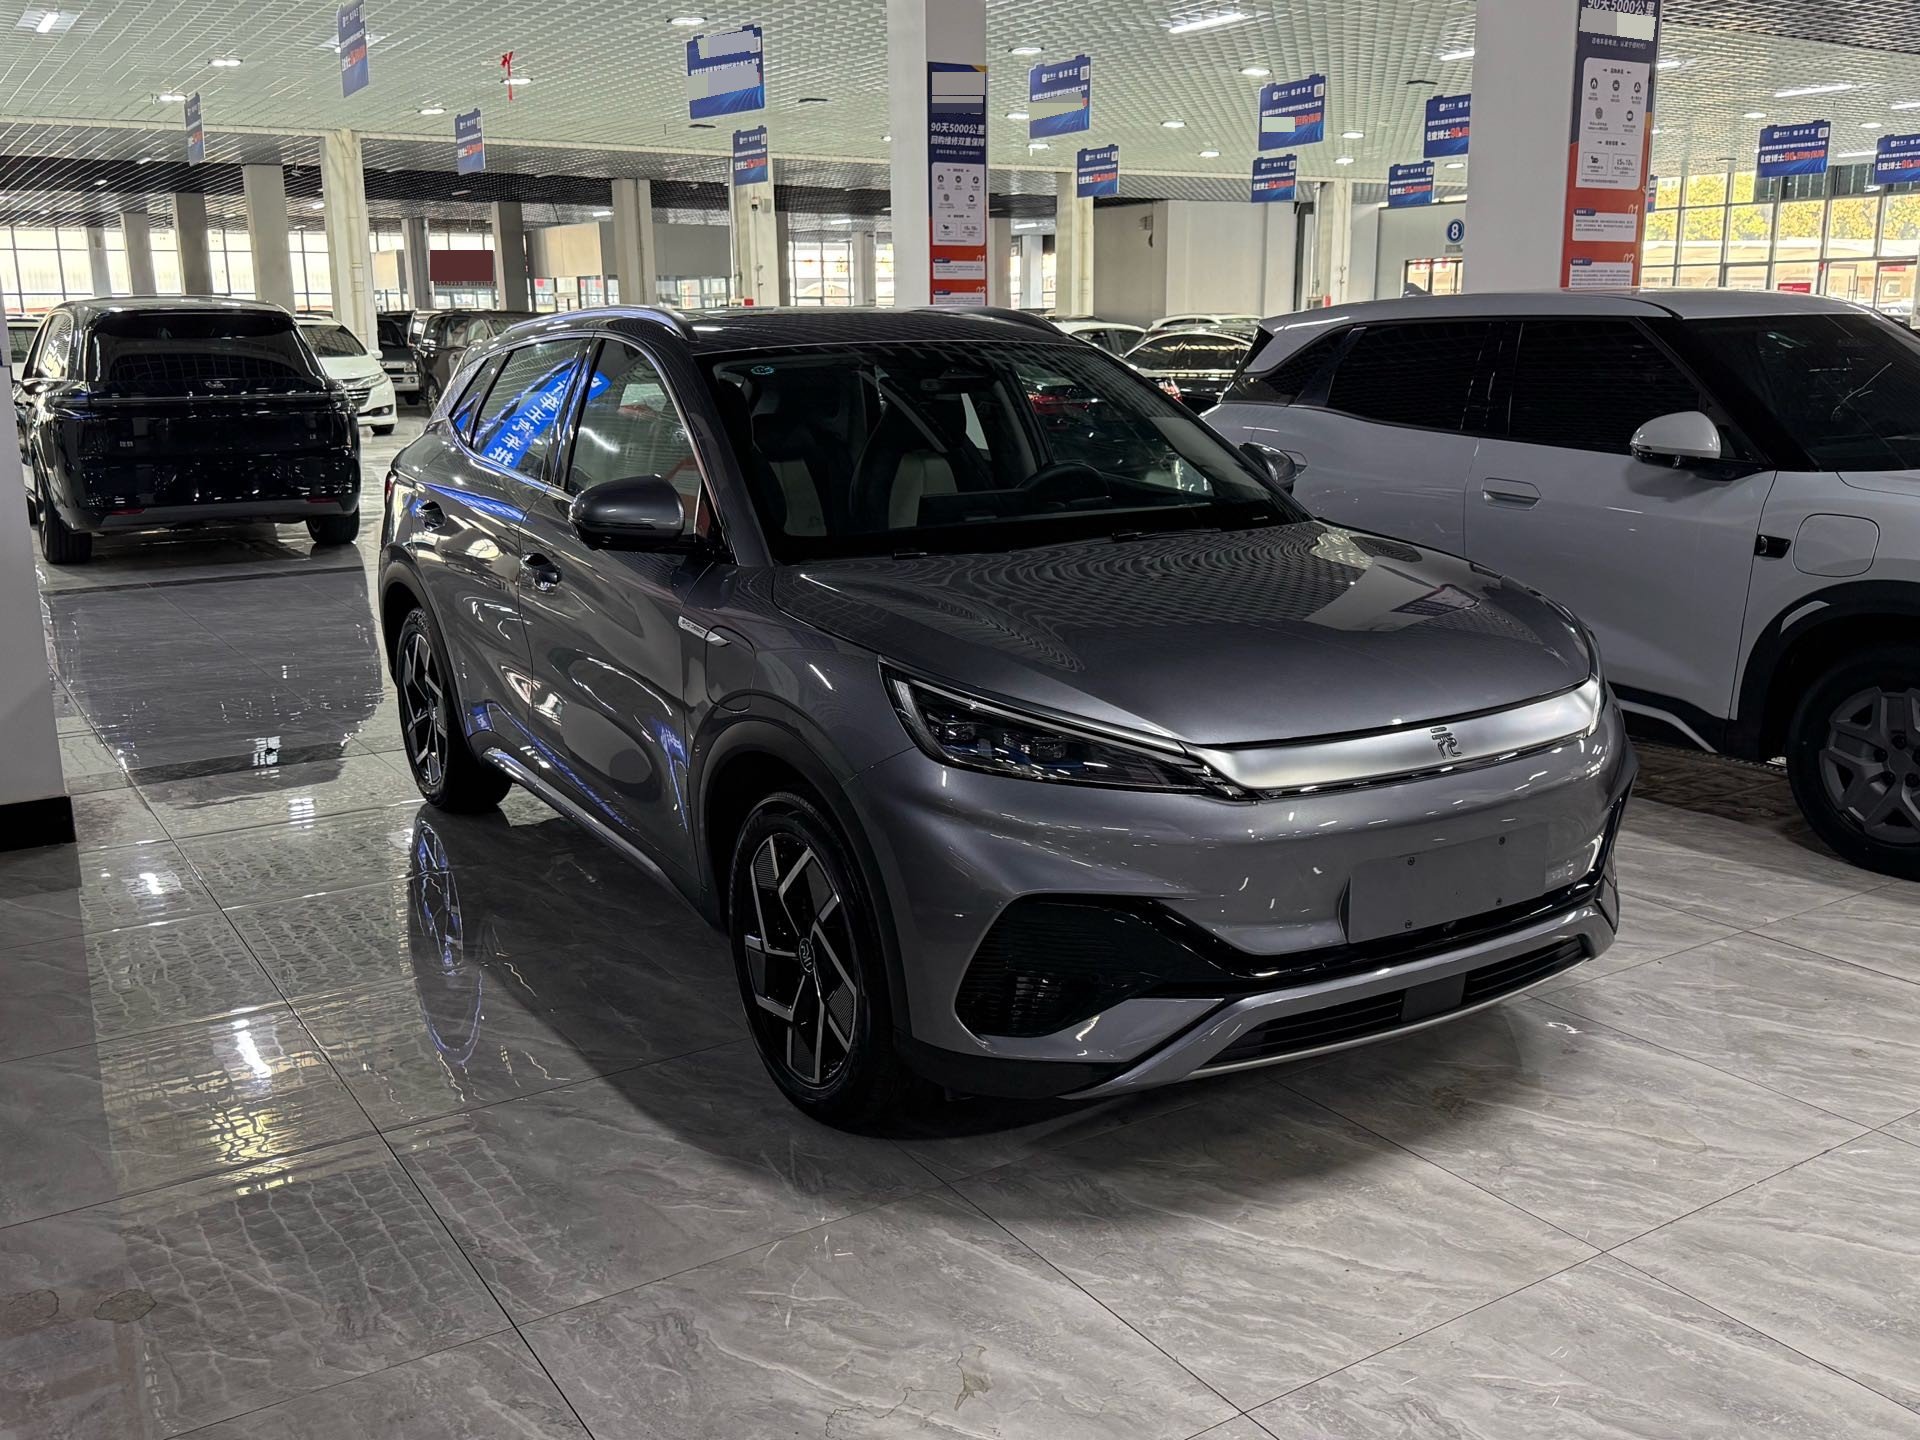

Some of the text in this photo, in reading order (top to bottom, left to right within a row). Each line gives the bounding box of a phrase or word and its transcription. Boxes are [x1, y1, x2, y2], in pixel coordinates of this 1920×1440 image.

[1587, 0, 1655, 16] 90天5000公里
[930, 122, 985, 135] 90天5000公里
[1450, 223, 1459, 239] 8
[1430, 726, 1463, 760] 元
